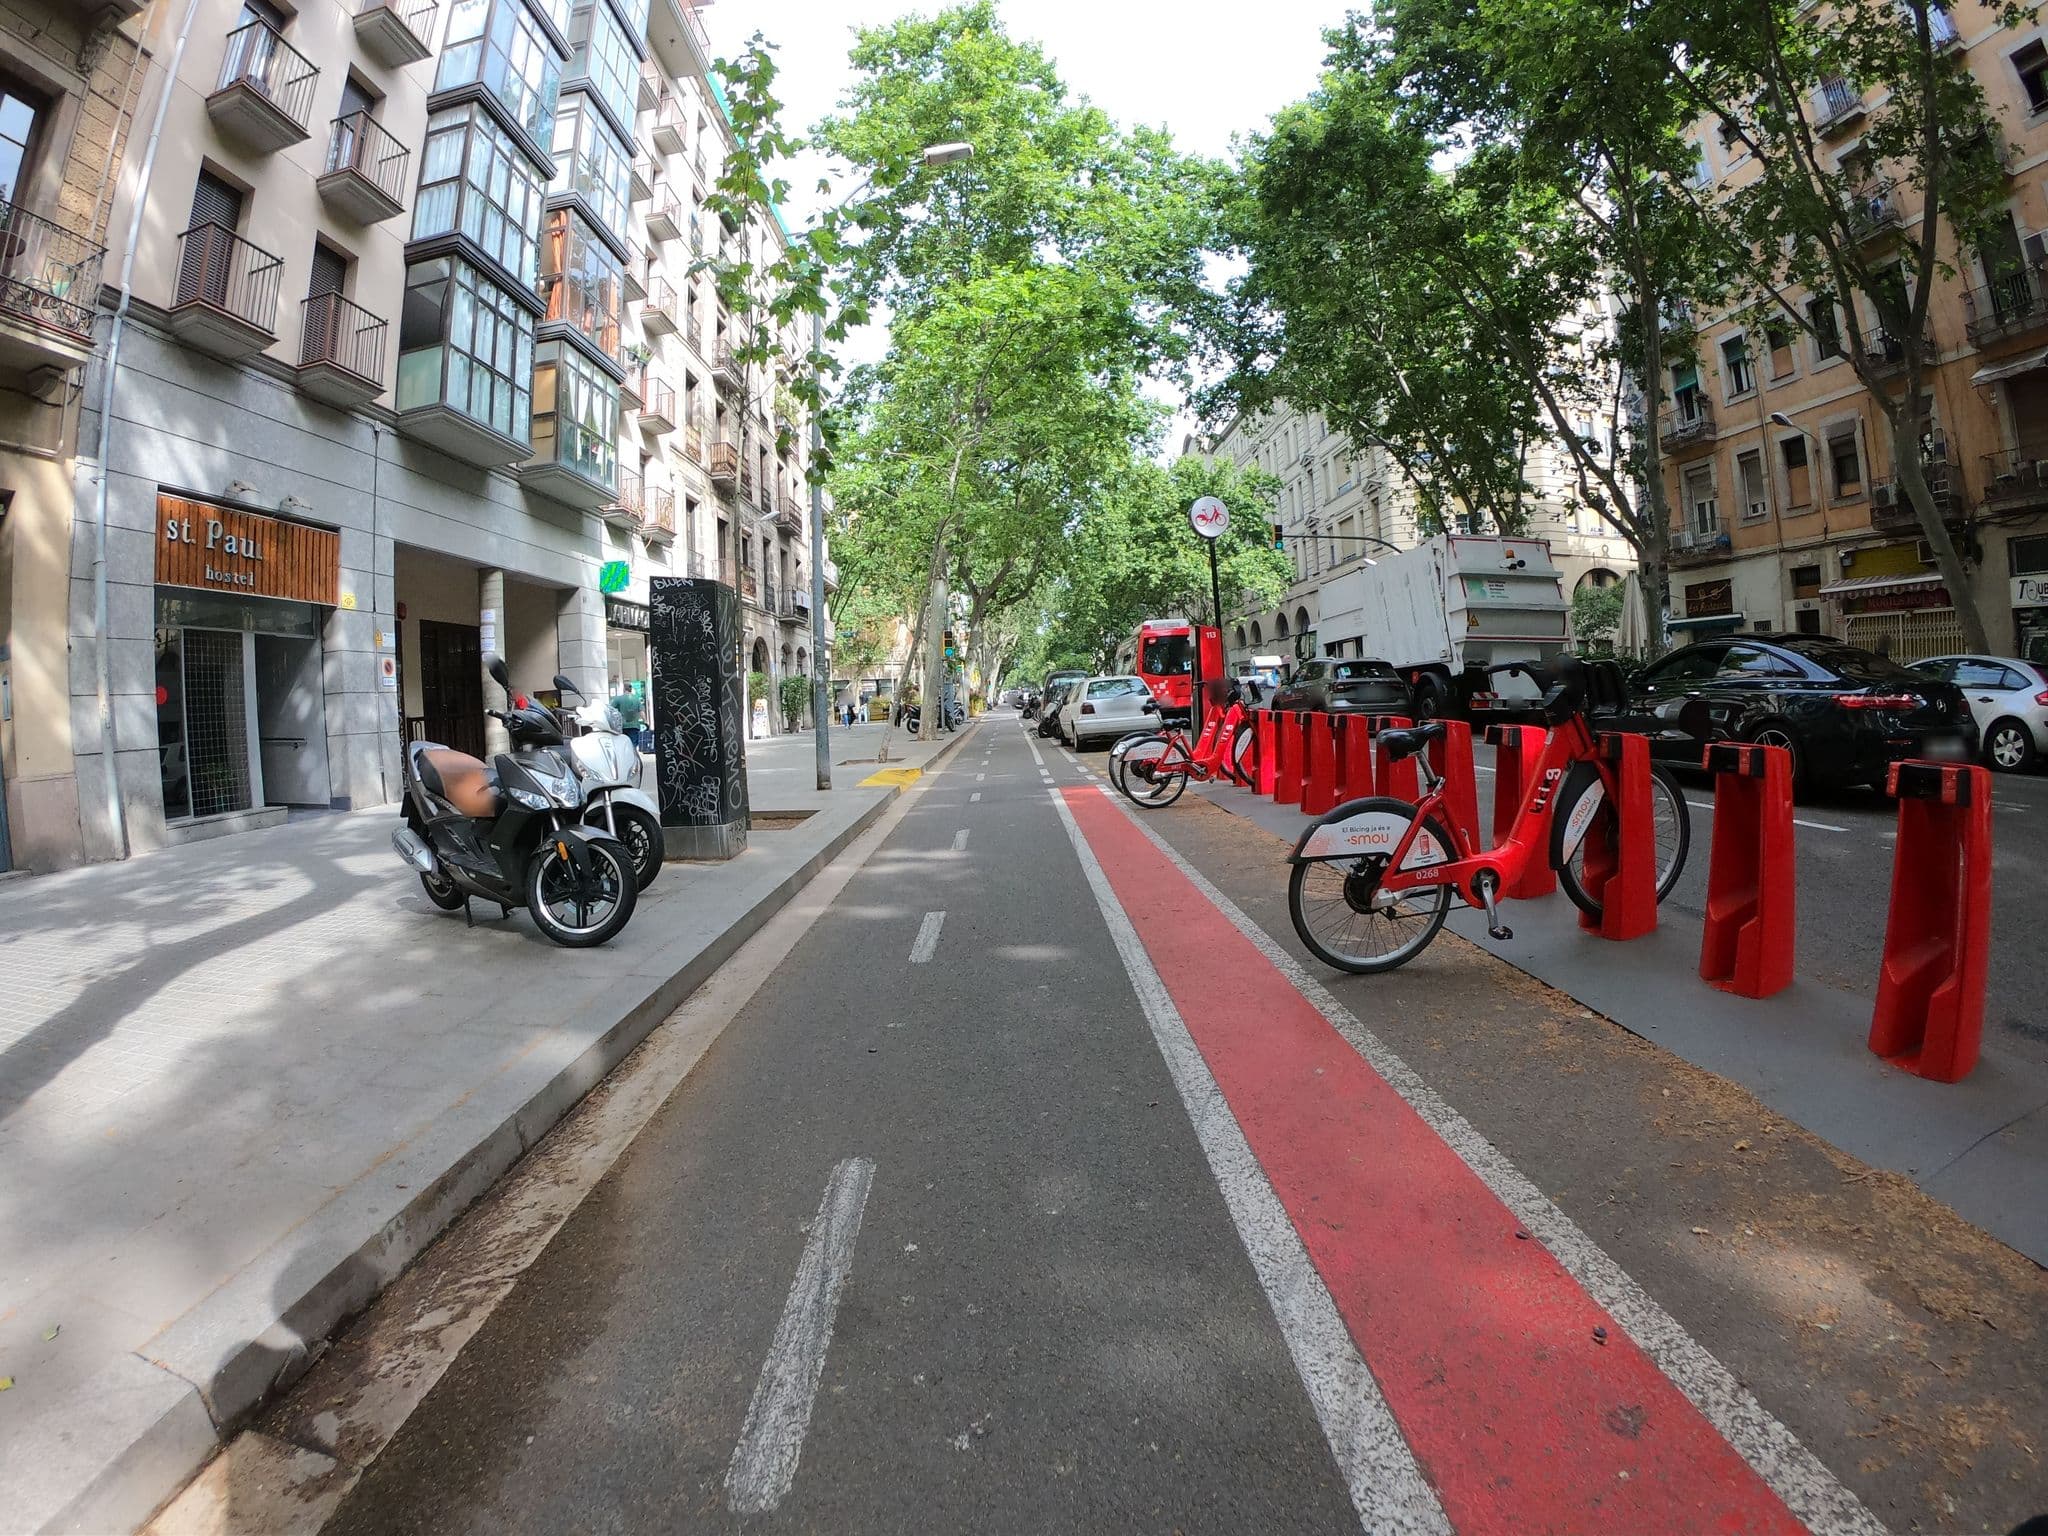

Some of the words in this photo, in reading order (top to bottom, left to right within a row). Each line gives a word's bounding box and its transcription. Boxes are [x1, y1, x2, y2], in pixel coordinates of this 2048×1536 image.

[205, 564, 254, 586] hostel
[1205, 631, 1217, 639] 113
[1349, 825, 1370, 833] Bicing
[1350, 833, 1389, 845] smou
[1415, 869, 1439, 880] 0268
